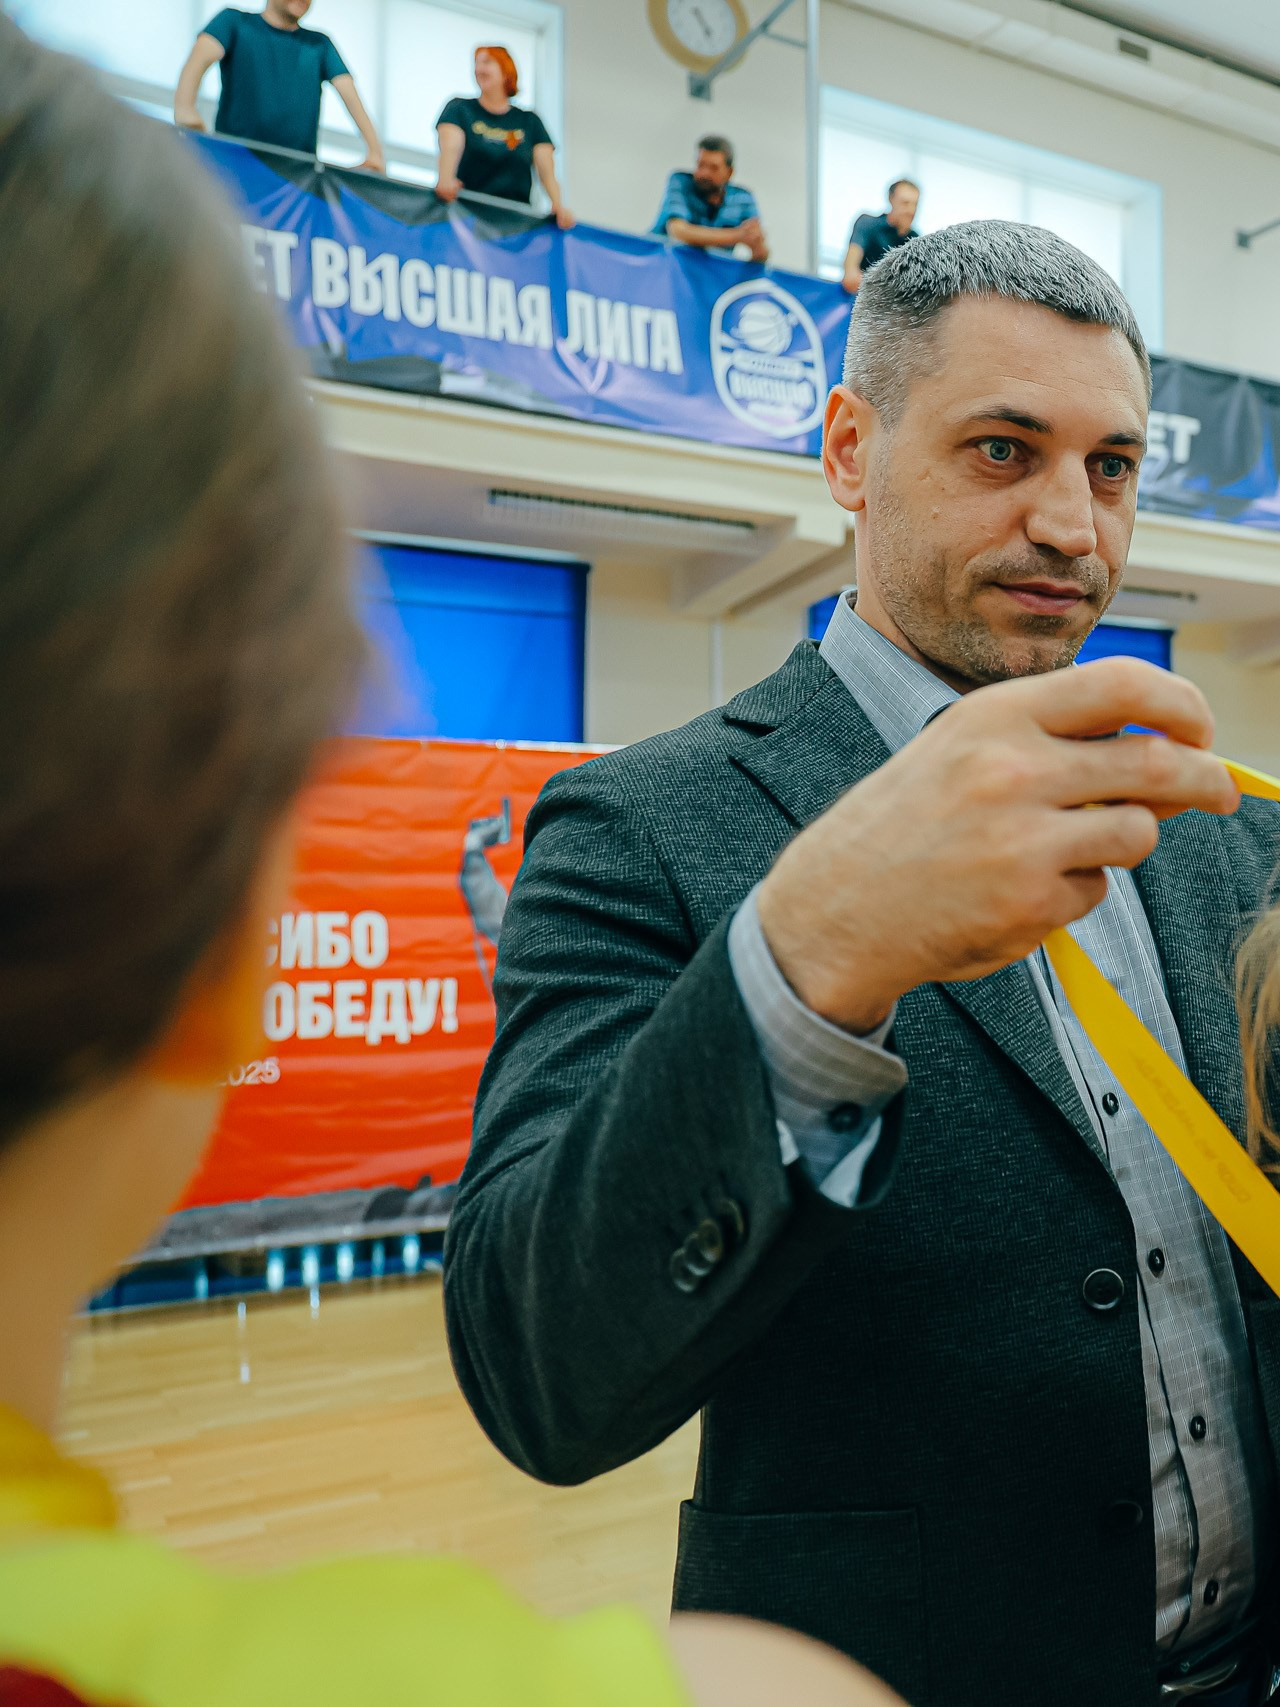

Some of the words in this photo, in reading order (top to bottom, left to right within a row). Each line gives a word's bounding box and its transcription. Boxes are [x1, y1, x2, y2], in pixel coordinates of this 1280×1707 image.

[310, 236, 554, 351] ВЫСШАЯ
[564, 288, 684, 376] ЛИГА
[268, 910, 390, 968] ИБО
[262, 978, 459, 1045] ОБЕДУ!
